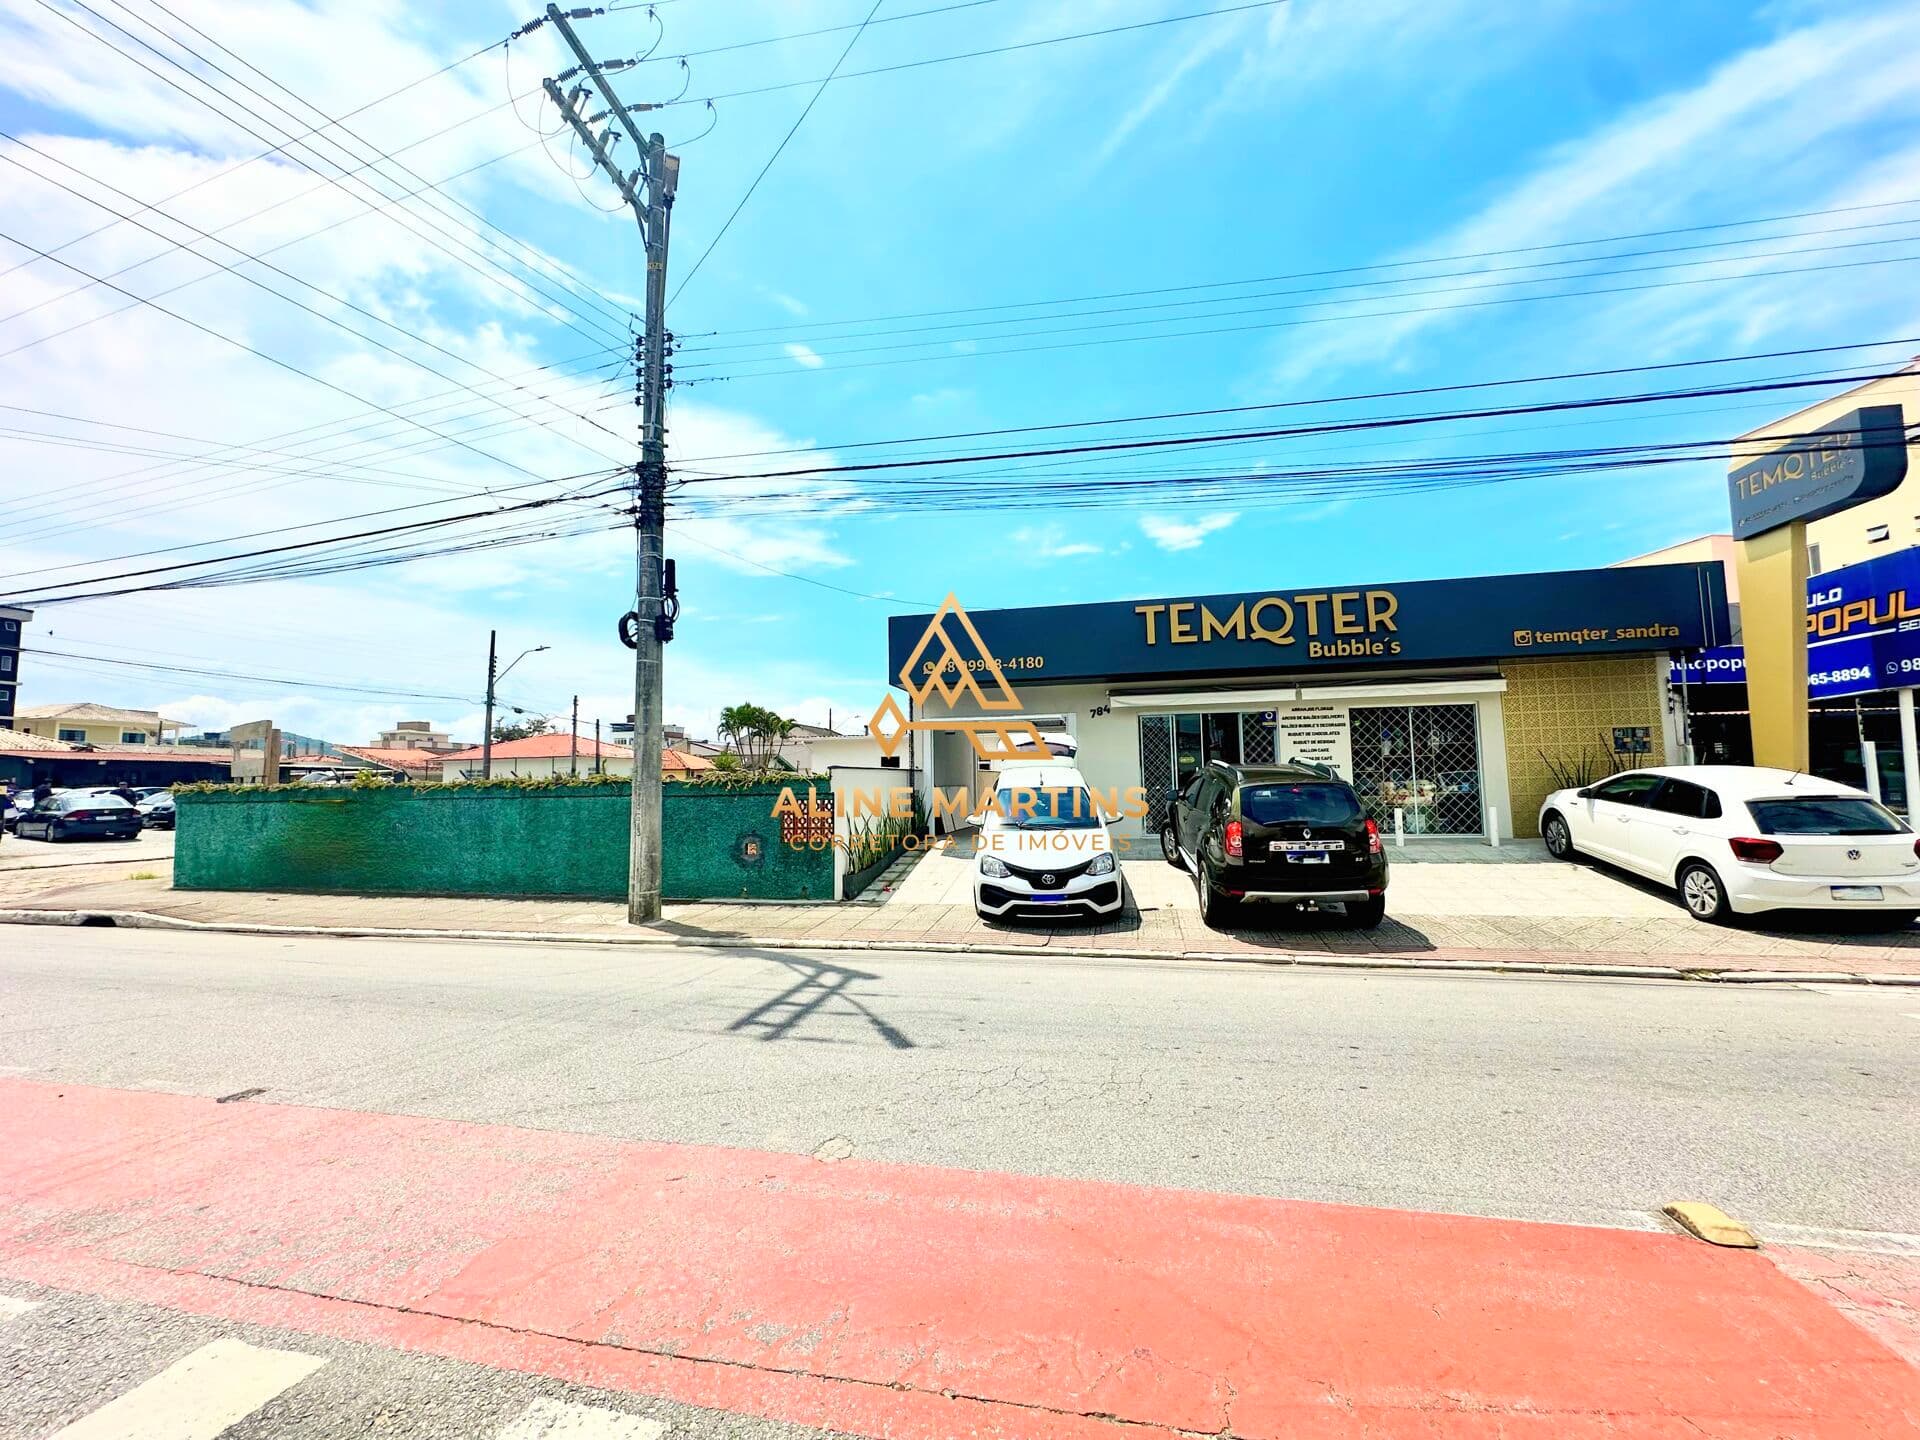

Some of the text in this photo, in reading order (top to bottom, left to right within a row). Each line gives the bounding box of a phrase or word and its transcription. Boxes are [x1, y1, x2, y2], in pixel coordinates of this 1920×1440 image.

[1135, 588, 1399, 646] TEMQTER
[1534, 623, 1680, 645] temqter_sandra
[1808, 665, 1871, 686] 65-8894
[1090, 704, 1111, 719] 784
